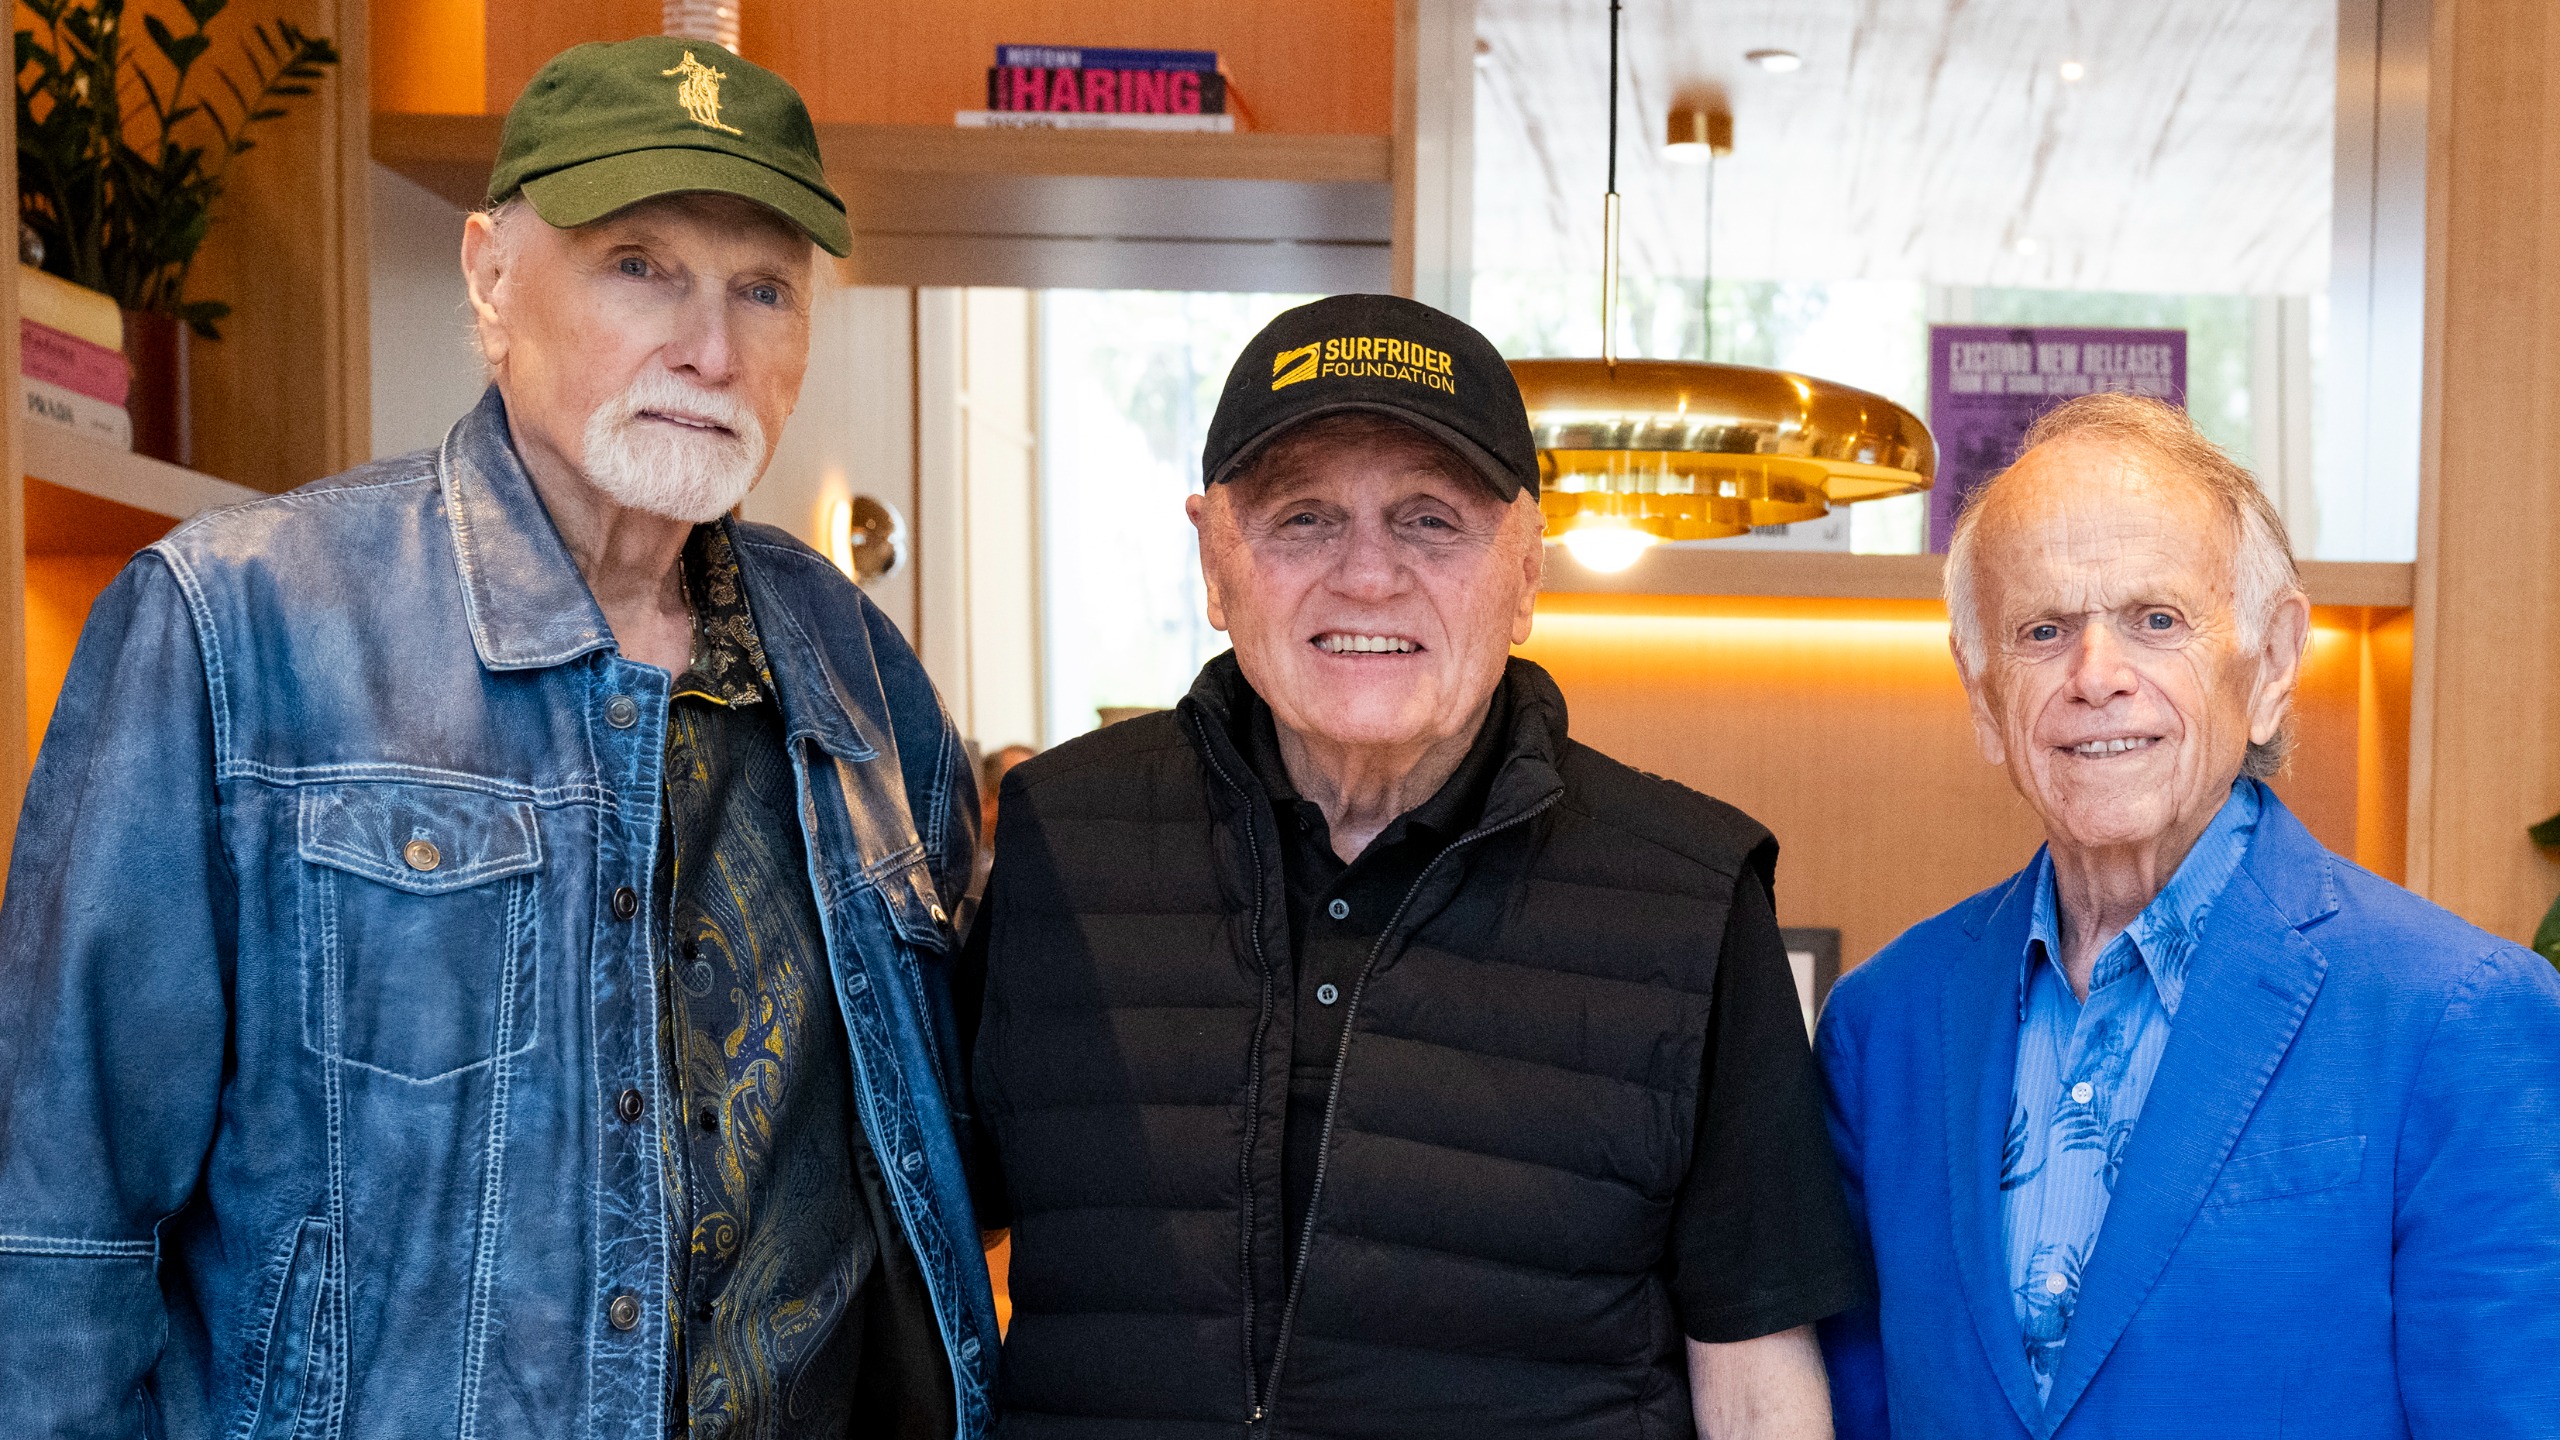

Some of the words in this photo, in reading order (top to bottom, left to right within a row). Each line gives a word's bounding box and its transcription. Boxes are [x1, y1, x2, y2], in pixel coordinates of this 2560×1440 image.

[1011, 66, 1201, 114] HARING
[1325, 337, 1454, 376] SURFRIDER
[1949, 341, 2033, 373] EXCITING
[2037, 342, 2079, 374] NEW
[2083, 343, 2172, 376] RELEASES
[1322, 362, 1455, 394] FOUNDATION
[26, 391, 75, 425] PRADA
